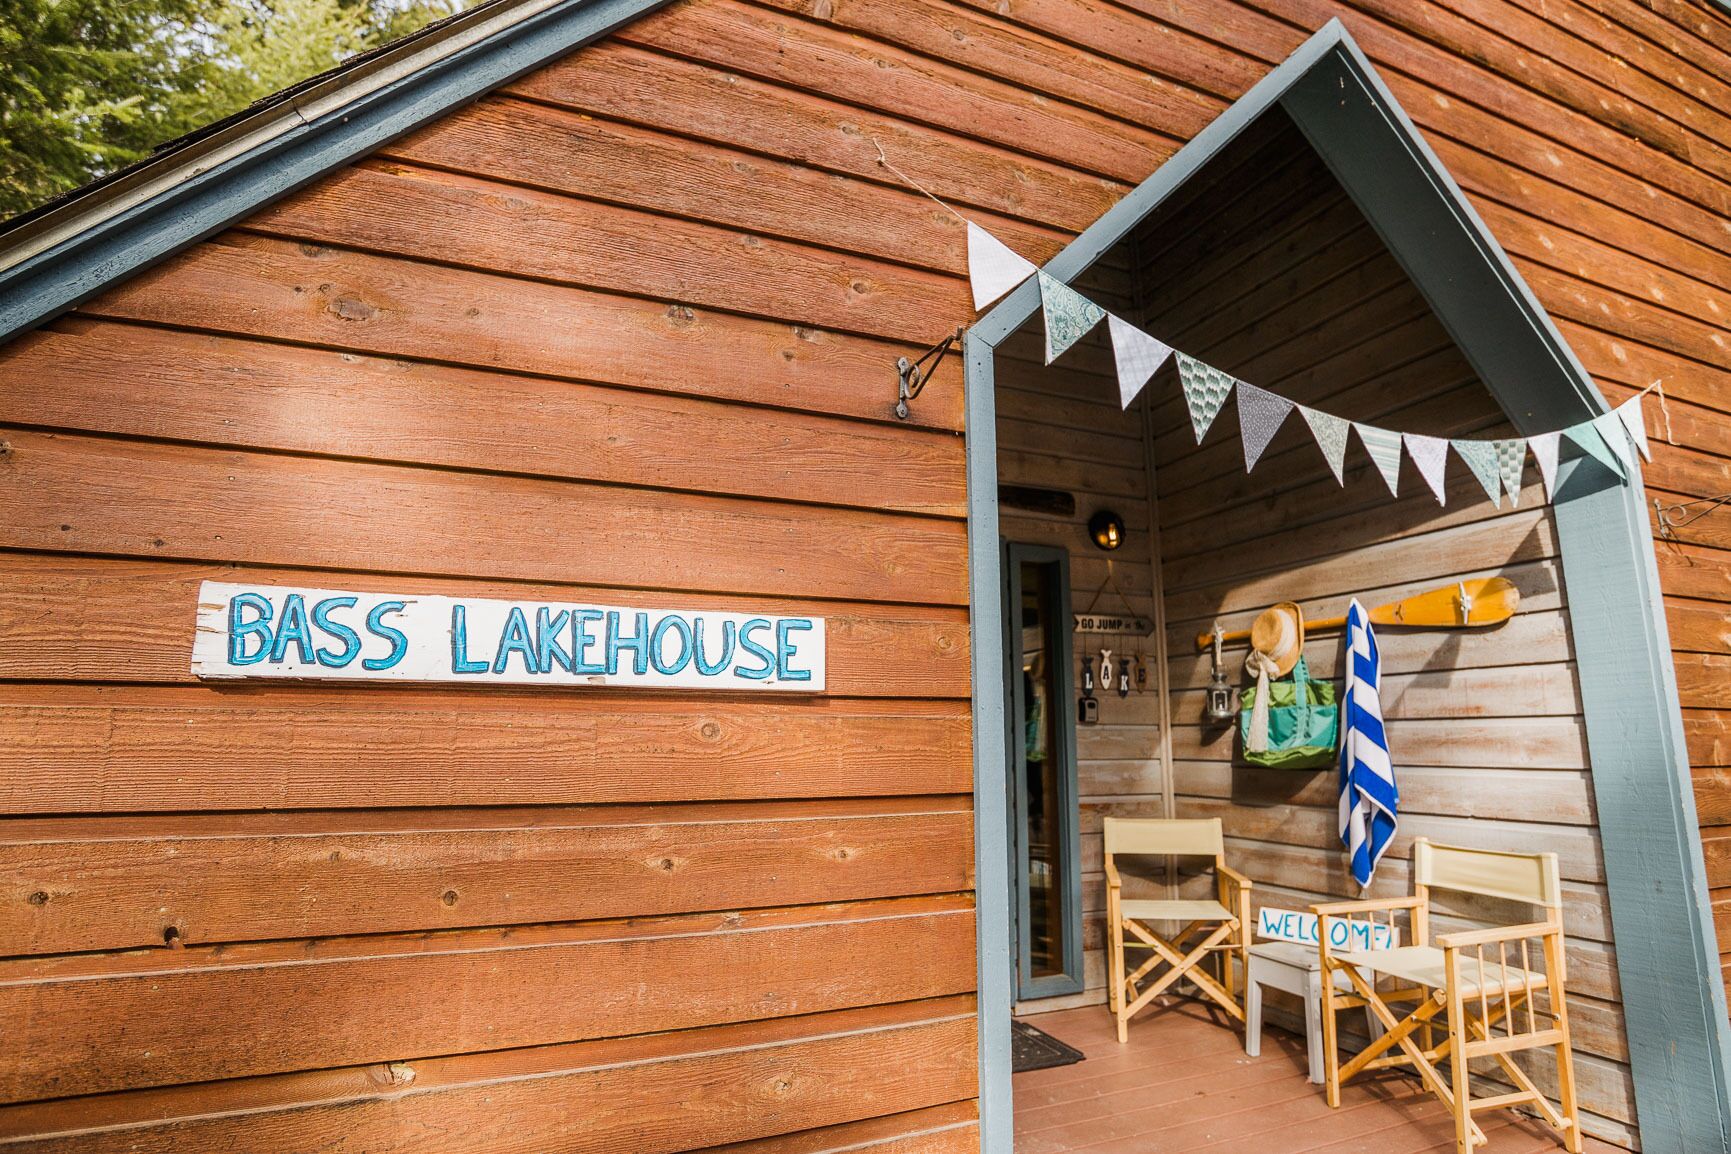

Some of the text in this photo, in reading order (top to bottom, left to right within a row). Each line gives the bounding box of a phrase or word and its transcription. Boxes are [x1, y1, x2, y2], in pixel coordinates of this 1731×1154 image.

[227, 592, 813, 682] BASS LAKEHOUSE
[1081, 618, 1094, 630] GO
[1096, 618, 1122, 630] JUMP
